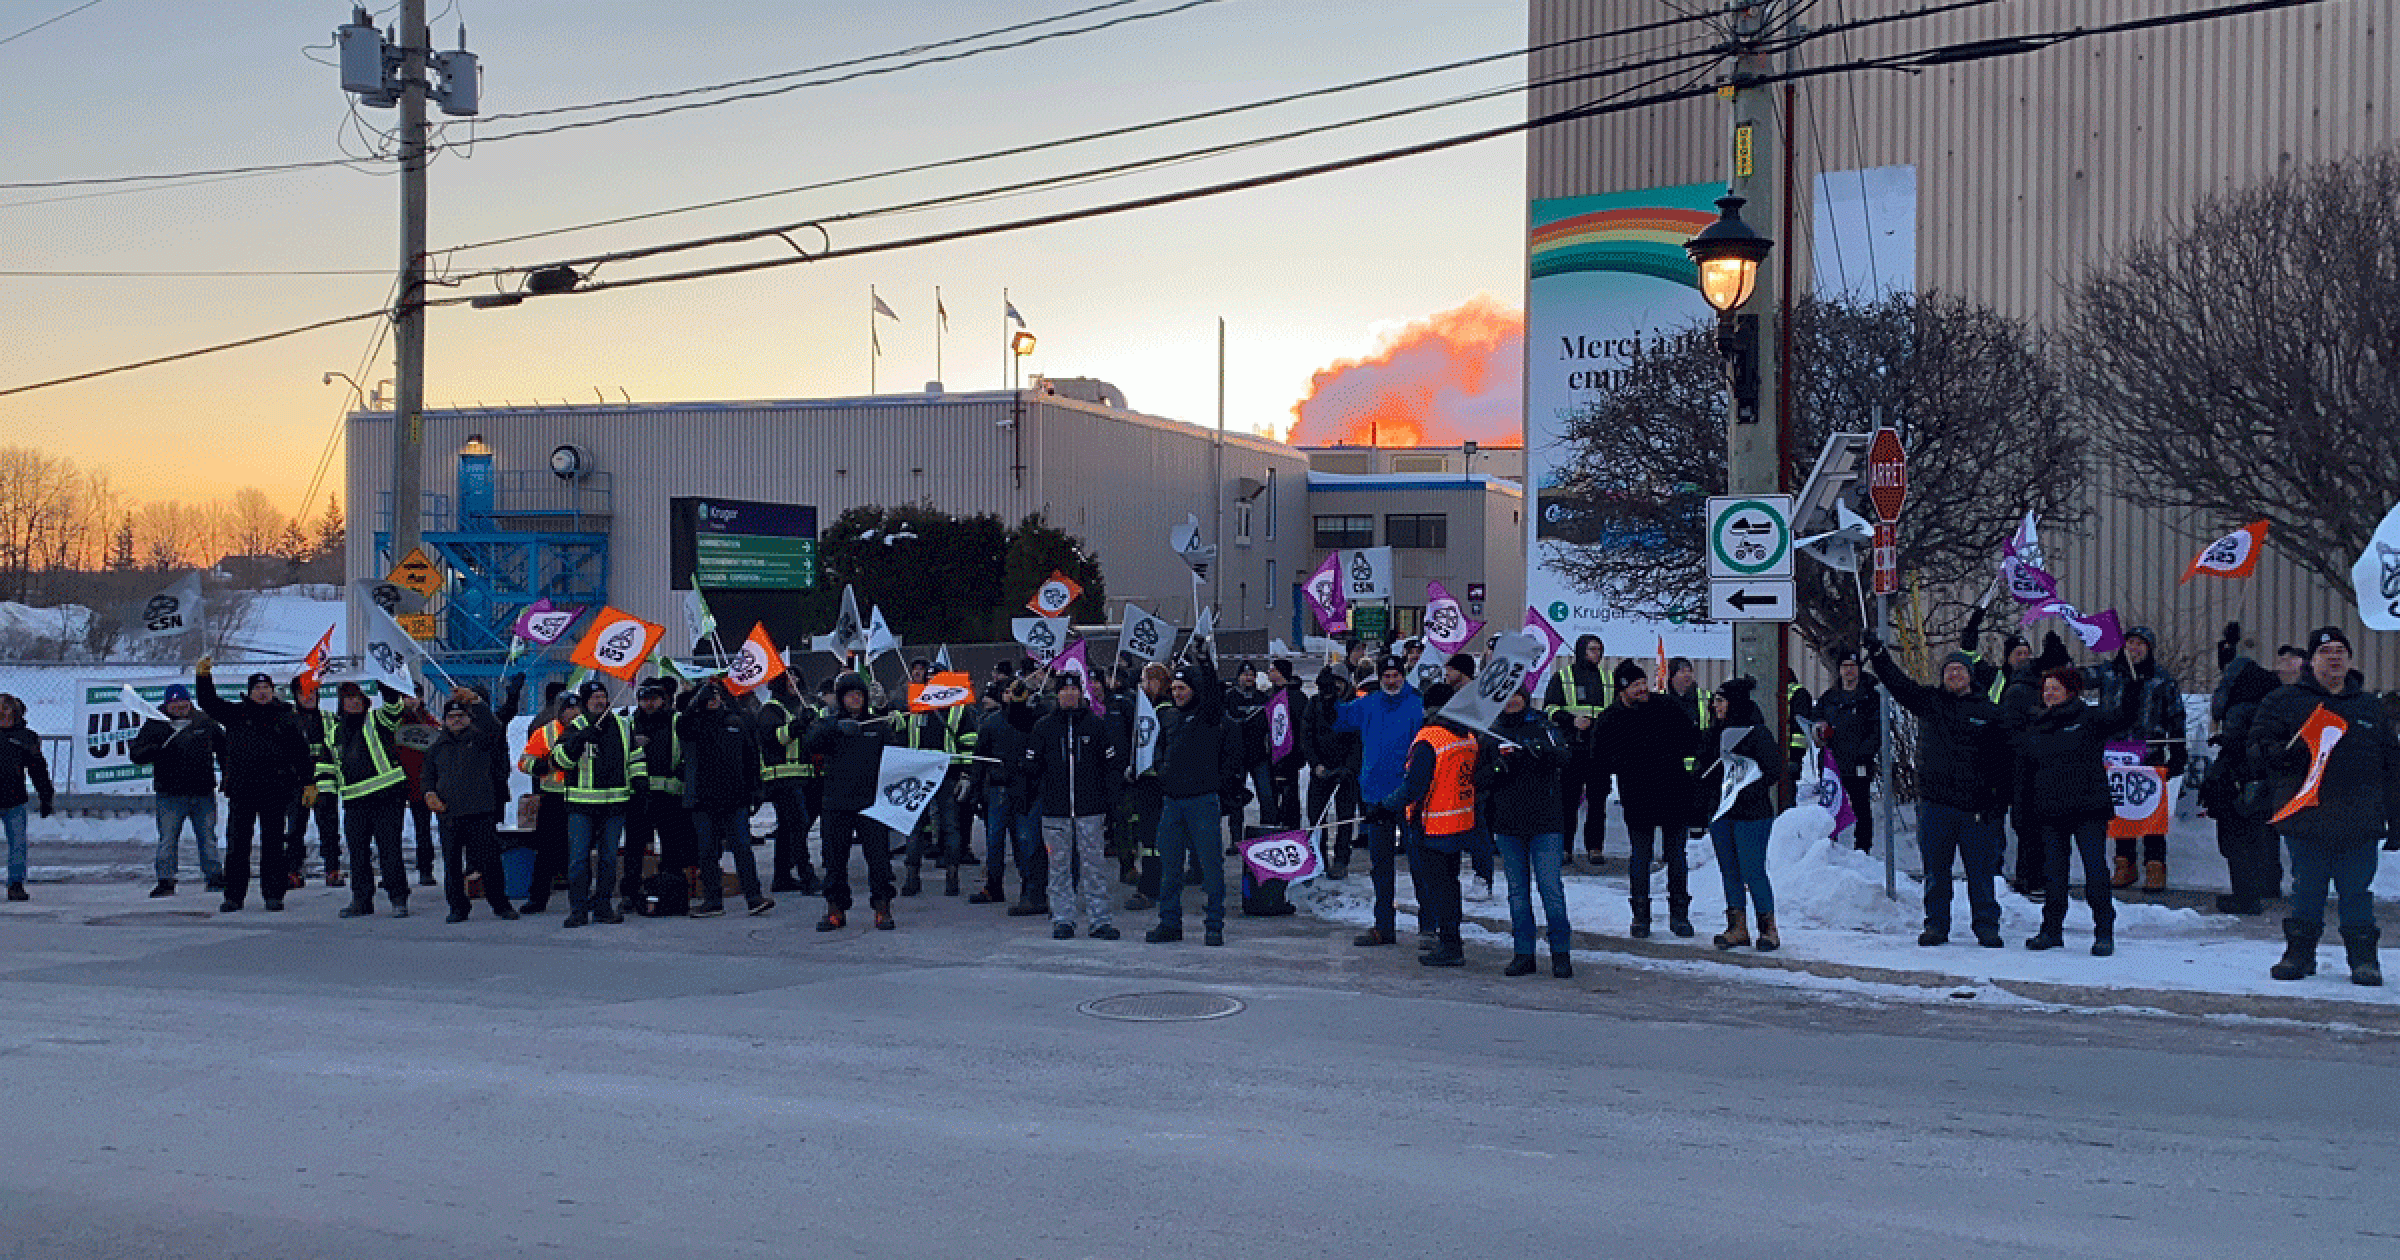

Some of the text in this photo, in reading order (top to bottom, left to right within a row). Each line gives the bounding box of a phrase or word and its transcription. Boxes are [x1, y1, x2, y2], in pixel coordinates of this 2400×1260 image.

[1560, 330, 1641, 360] Merci
[1872, 457, 1904, 487] ARRÊT
[1353, 582, 1375, 593] CSN
[147, 615, 183, 631] CSN
[1129, 638, 1156, 657] CSN
[1491, 662, 1524, 702] CSN
[905, 780, 937, 812] CSN
[2110, 772, 2125, 806] CSN
[1285, 844, 1301, 867] CSN
